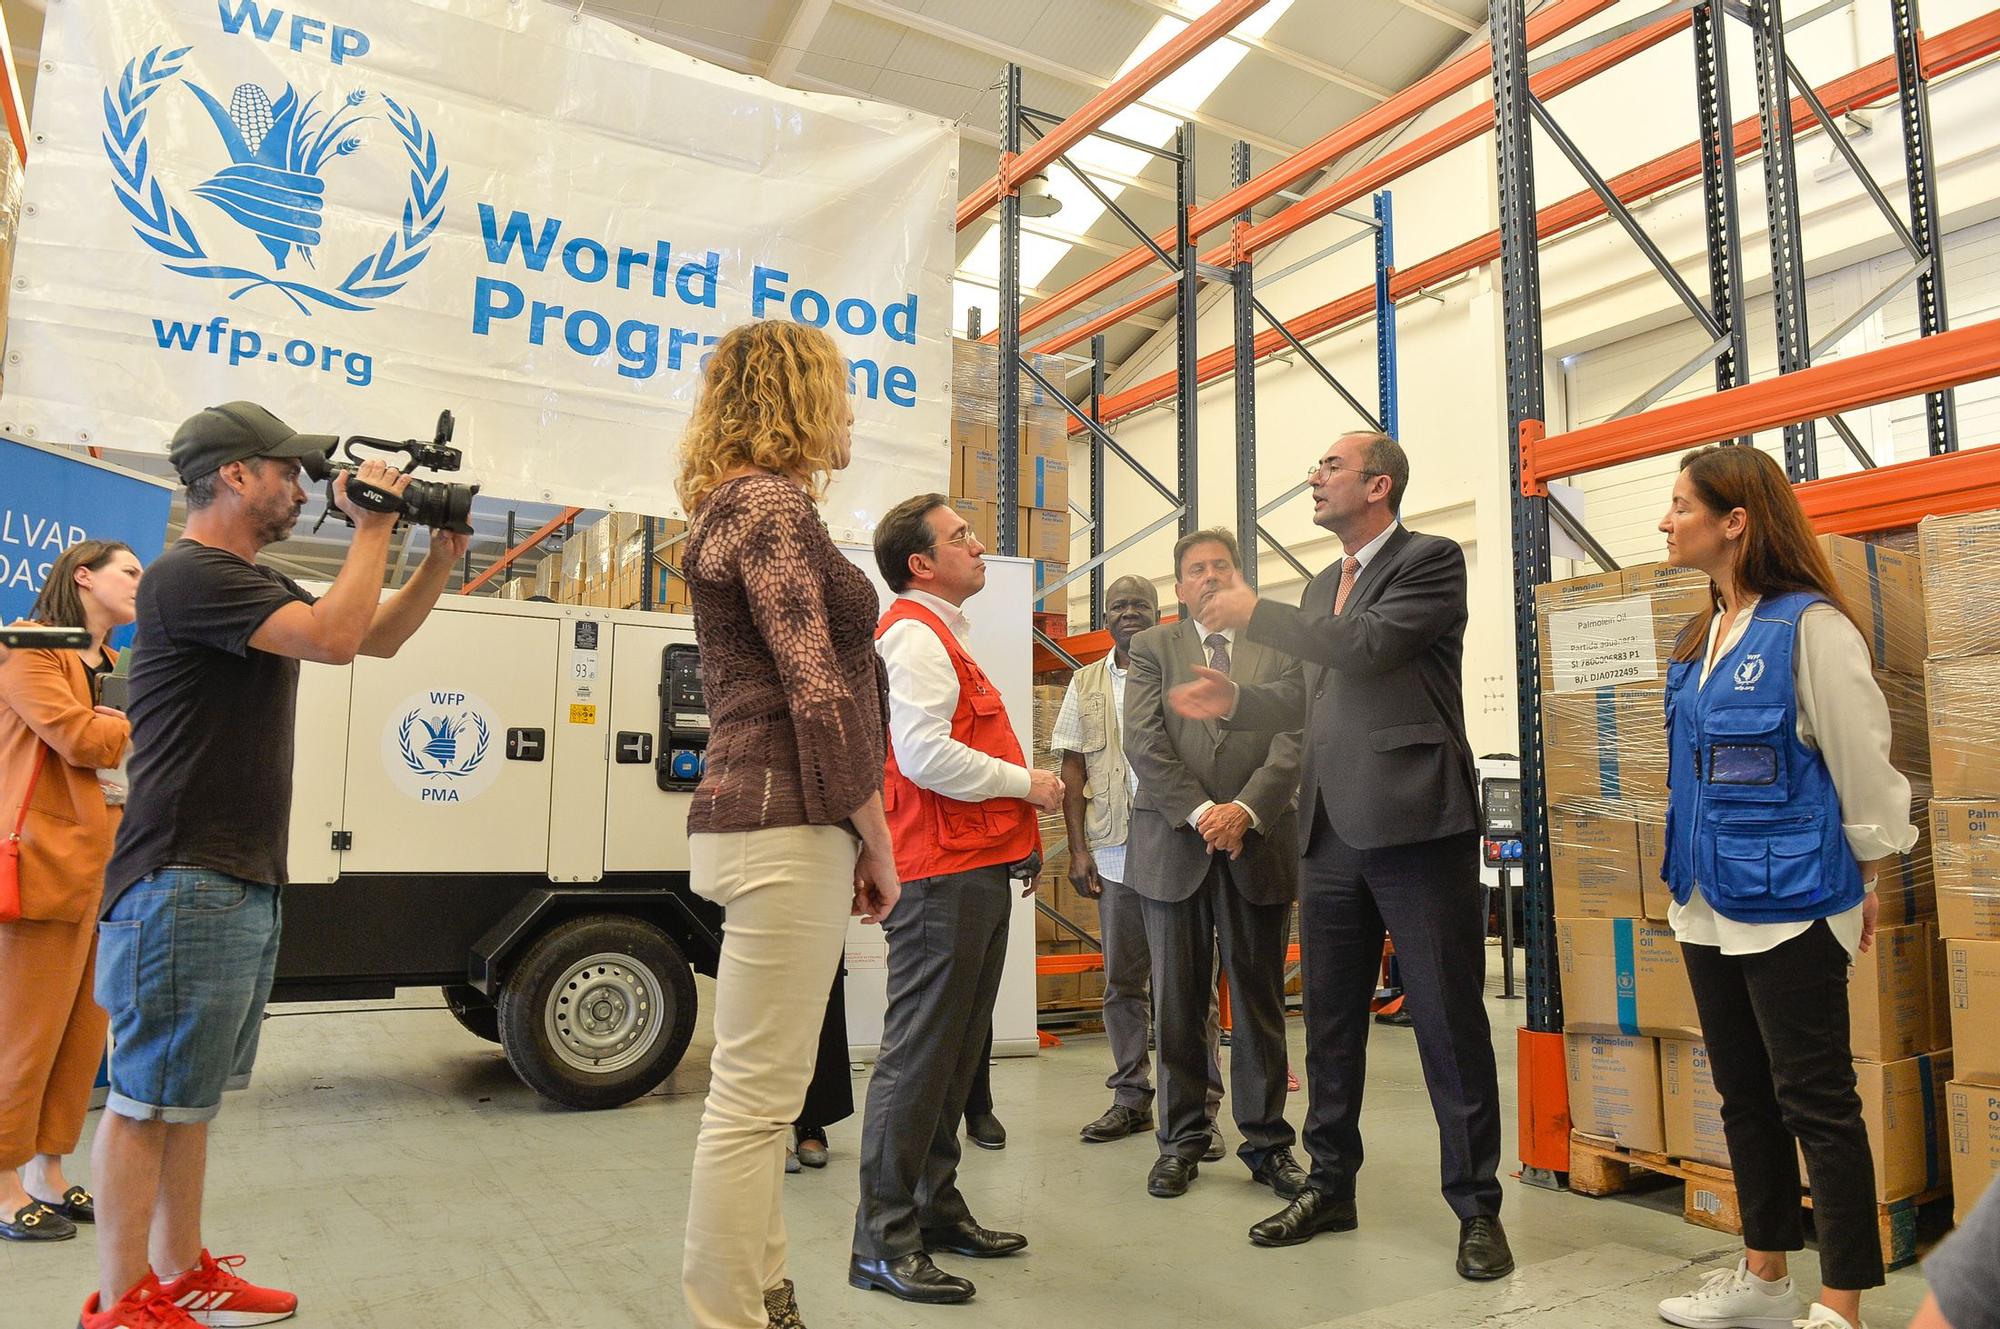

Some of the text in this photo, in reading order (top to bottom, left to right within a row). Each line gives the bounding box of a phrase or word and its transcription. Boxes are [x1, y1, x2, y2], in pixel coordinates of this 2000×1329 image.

[218, 0, 371, 66] WFP
[477, 202, 919, 345] World Food
[472, 275, 918, 408] Progrme
[152, 316, 373, 387] wfp.org
[363, 490, 384, 503] JVC
[1561, 582, 1604, 594] Palmolein
[1577, 613, 1627, 630] Palmolein Oil
[1571, 660, 1579, 669] SI
[1629, 650, 1640, 659] P1
[575, 663, 588, 678] 93
[1574, 666, 1639, 684] B/L DJA0722495
[429, 691, 466, 706] WFP
[421, 788, 460, 802] PMA
[1968, 821, 1986, 831] Oil
[1639, 938, 1653, 947] Oil
[1591, 1035, 1634, 1048] Palmolein
[1591, 1046, 1604, 1055] Oil
[1692, 1058, 1706, 1068] Oil
[1989, 1111, 2000, 1121] O
